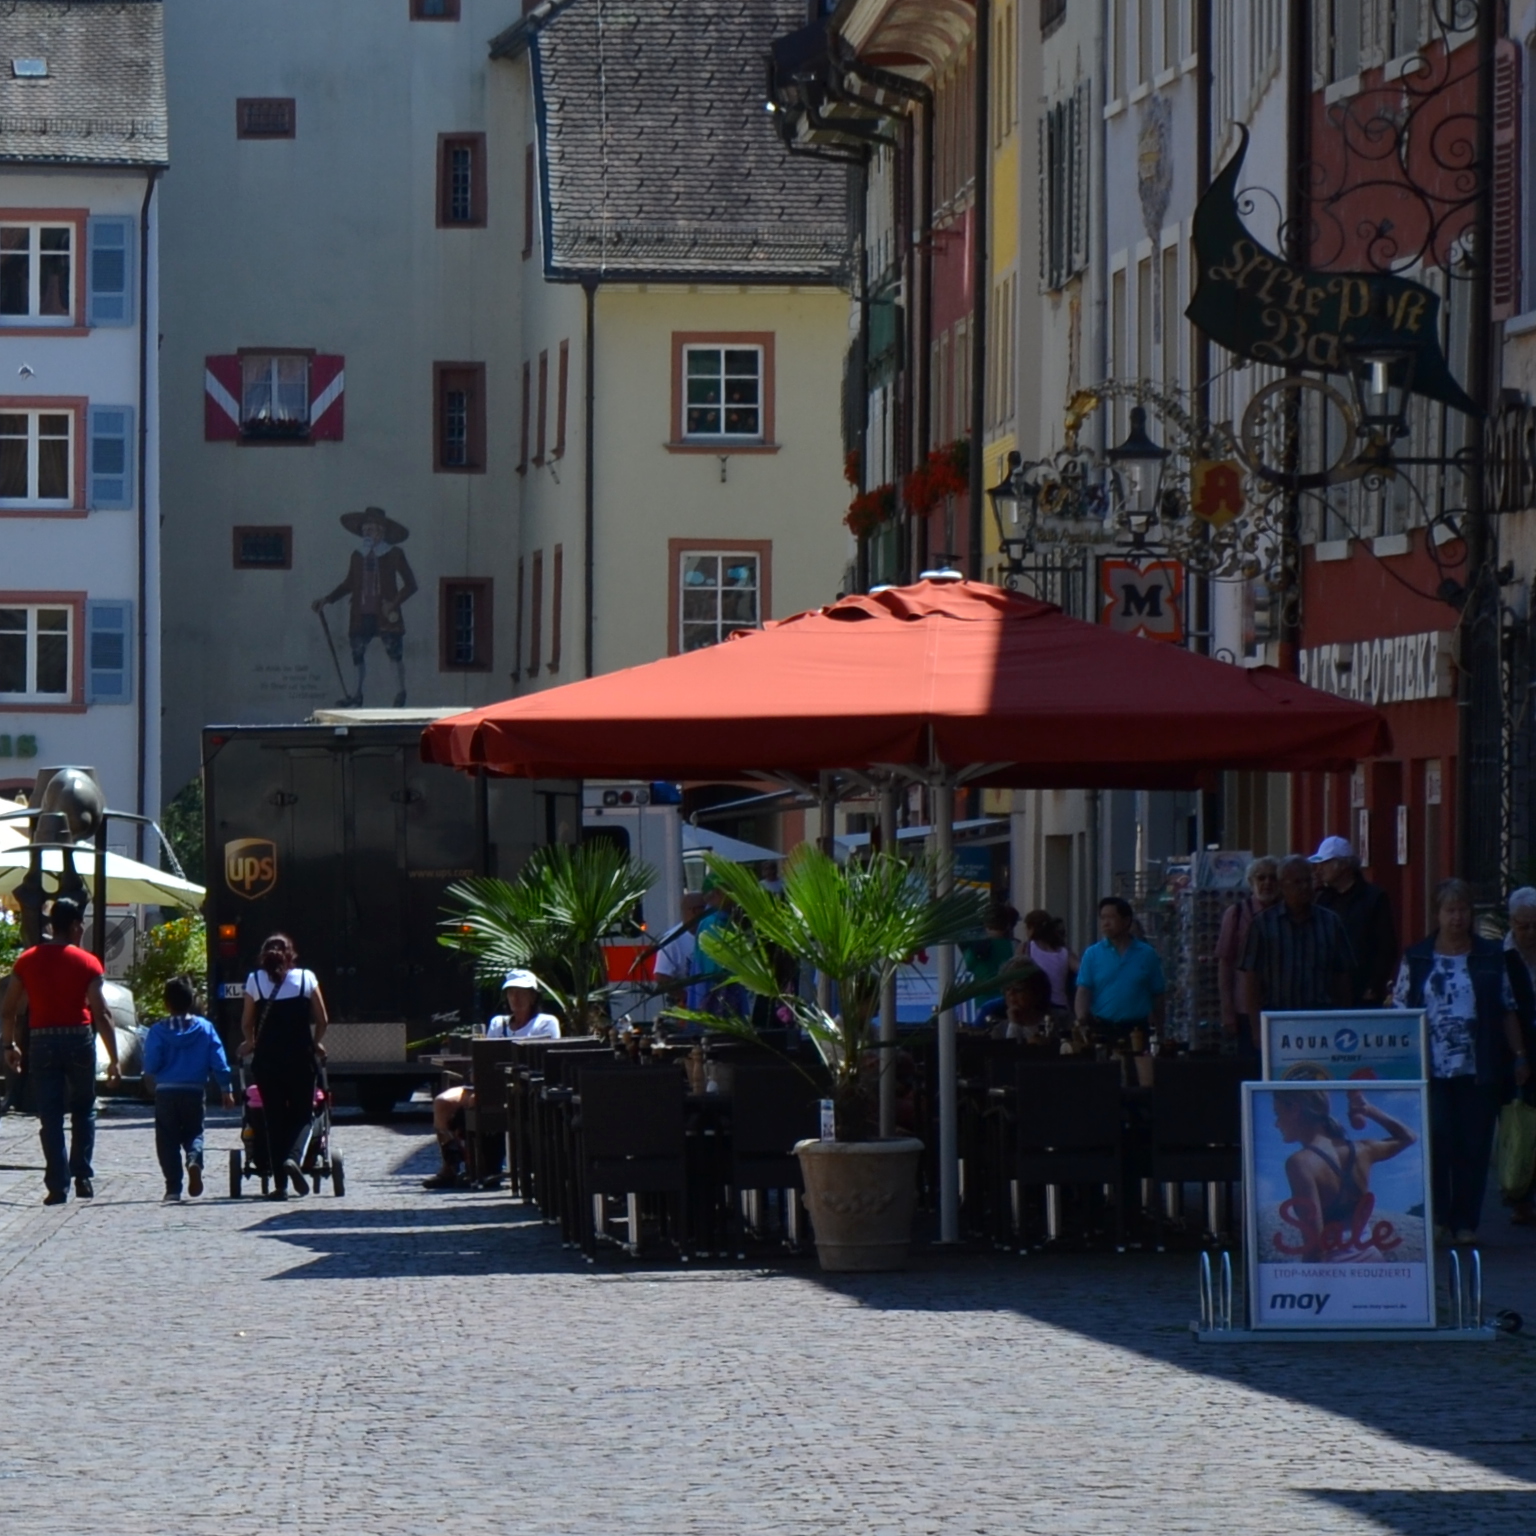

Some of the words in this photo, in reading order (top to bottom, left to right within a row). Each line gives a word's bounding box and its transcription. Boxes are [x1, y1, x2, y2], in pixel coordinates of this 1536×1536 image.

[1251, 307, 1355, 369] Ba
[1299, 630, 1439, 705] RATS-APOTHEKE
[229, 856, 274, 890] ups
[1281, 1032, 1328, 1050] AQUA
[1363, 1031, 1410, 1049] LUNG
[1330, 1054, 1362, 1063] SPORT
[1272, 1192, 1403, 1255] Sale
[1270, 1292, 1331, 1315] may
